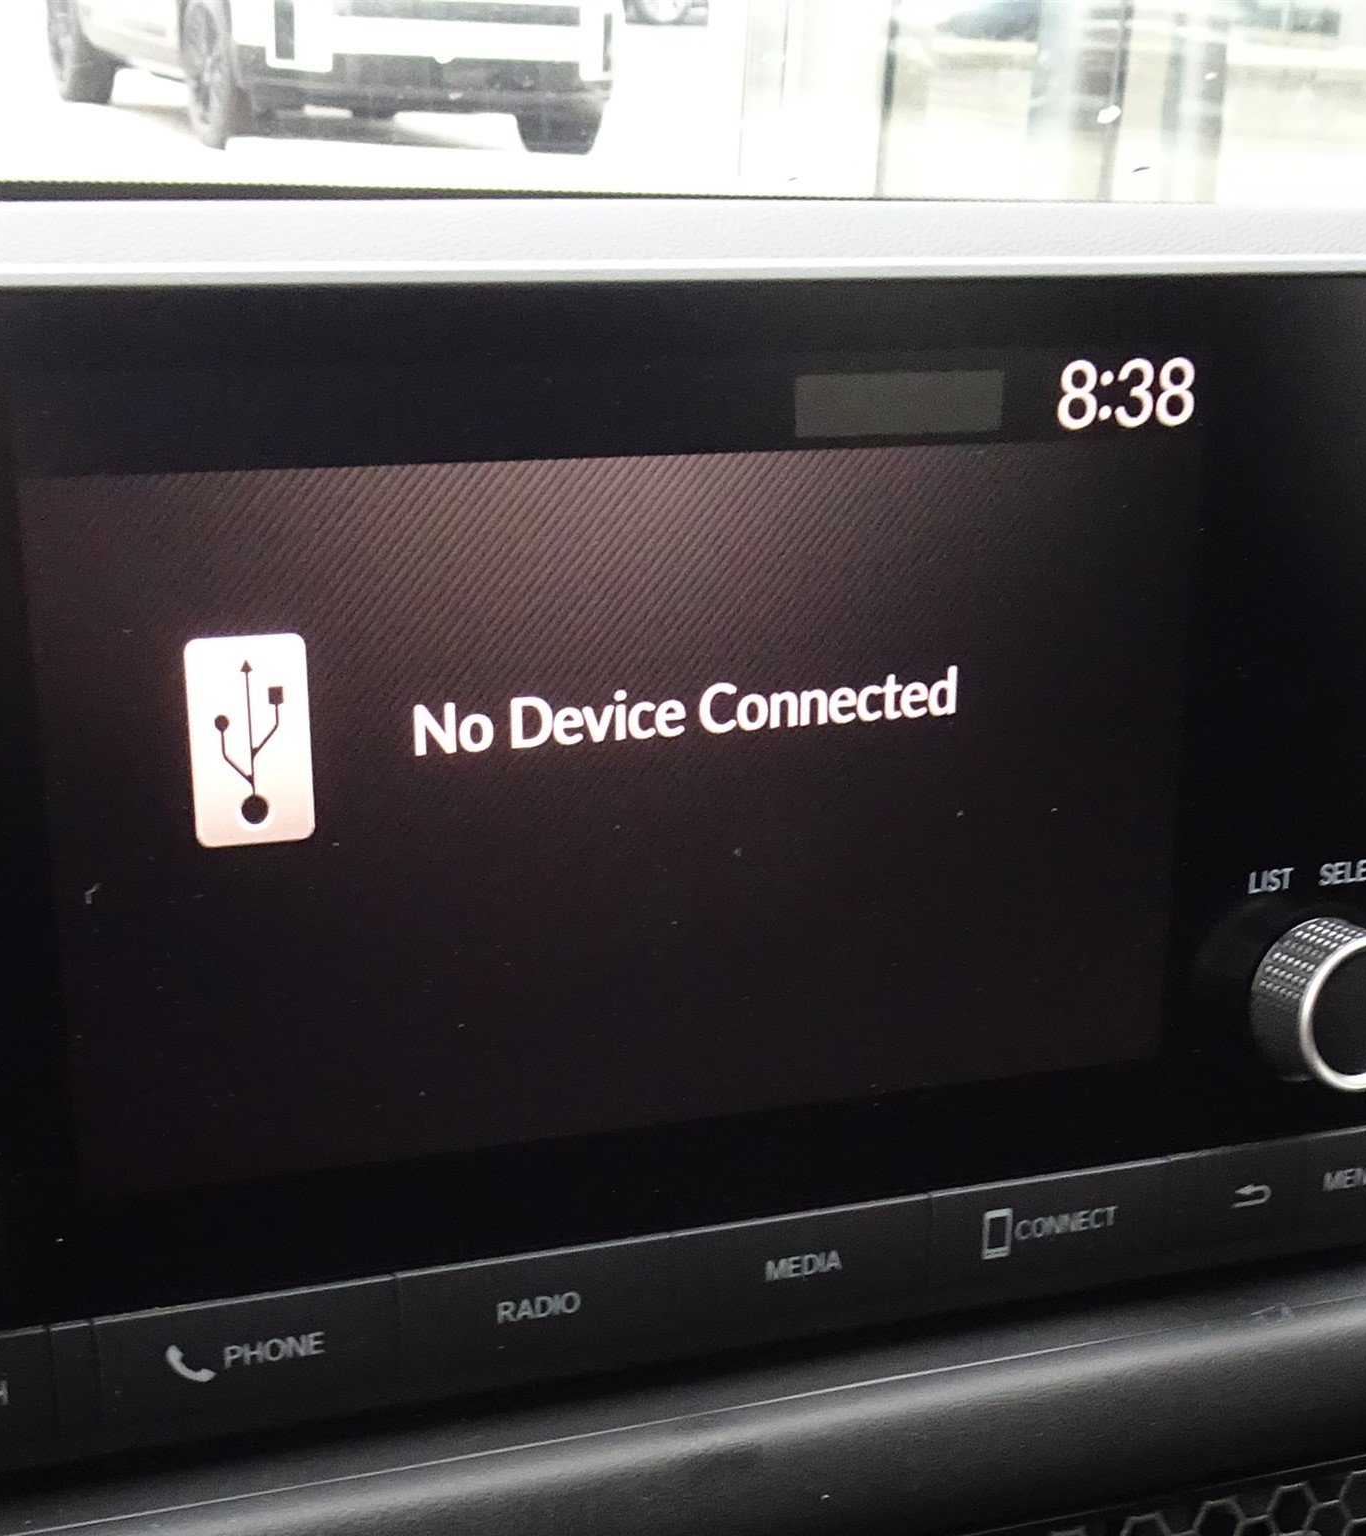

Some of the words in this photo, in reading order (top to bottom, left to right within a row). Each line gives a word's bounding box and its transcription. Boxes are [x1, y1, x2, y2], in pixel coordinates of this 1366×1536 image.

[1056, 356, 1196, 431] 8:38
[412, 701, 495, 757] No
[509, 689, 687, 750] Device
[698, 665, 958, 735] Connected
[1247, 866, 1295, 894] LIST
[1014, 1204, 1119, 1240] CONNECT
[764, 1250, 843, 1282] MEDIA
[495, 1291, 582, 1324] RADIO
[222, 1331, 326, 1368] PHONE
